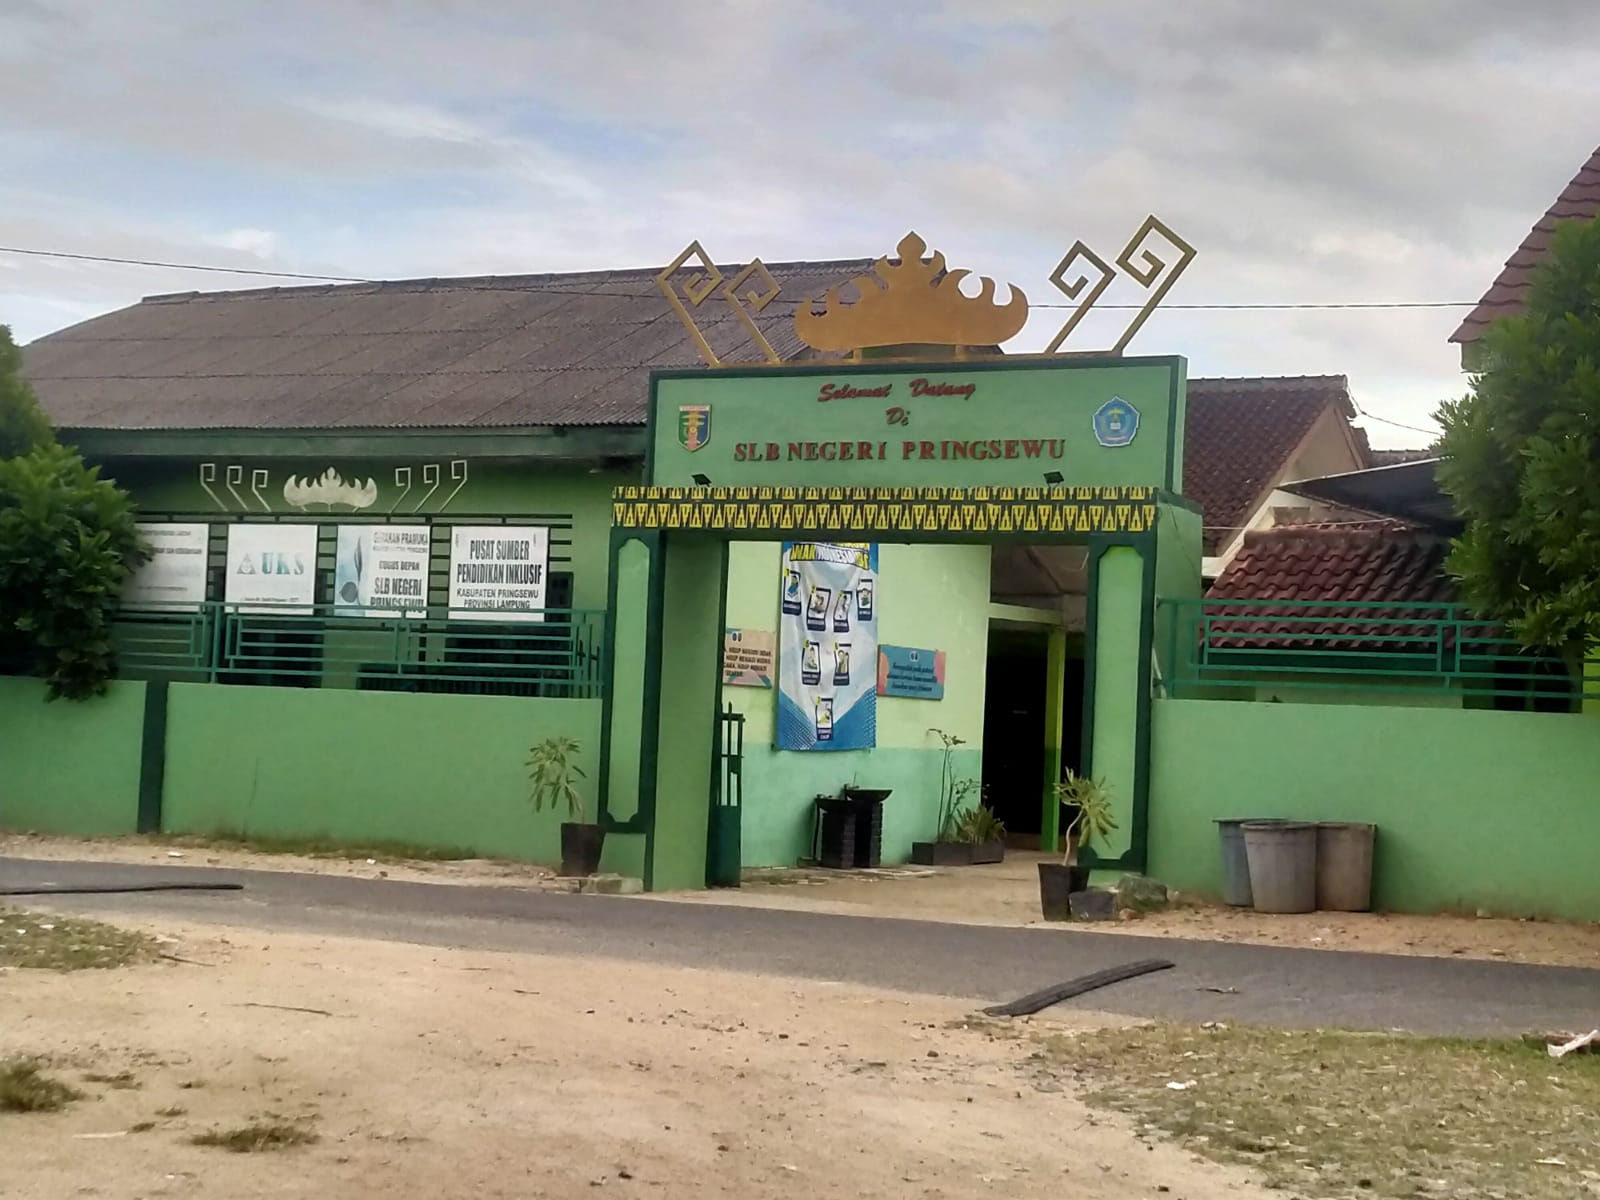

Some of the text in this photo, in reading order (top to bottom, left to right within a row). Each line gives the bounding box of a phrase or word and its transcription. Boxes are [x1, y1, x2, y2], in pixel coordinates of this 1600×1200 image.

[817, 378, 977, 402] Selamat Datang
[886, 406, 911, 426] Di
[734, 439, 1066, 461] SLB NEGERI PRINGSEWU
[469, 539, 530, 561] PUSAT SUMBER
[261, 552, 305, 576] UKS
[457, 563, 542, 584] PENDIDIKAN INKLUSIF
[374, 577, 422, 596] SLB NEGERI
[457, 588, 539, 598] KABUPATEN PRINGSEWU
[464, 599, 531, 609] PROVINSI LAMPUNG
